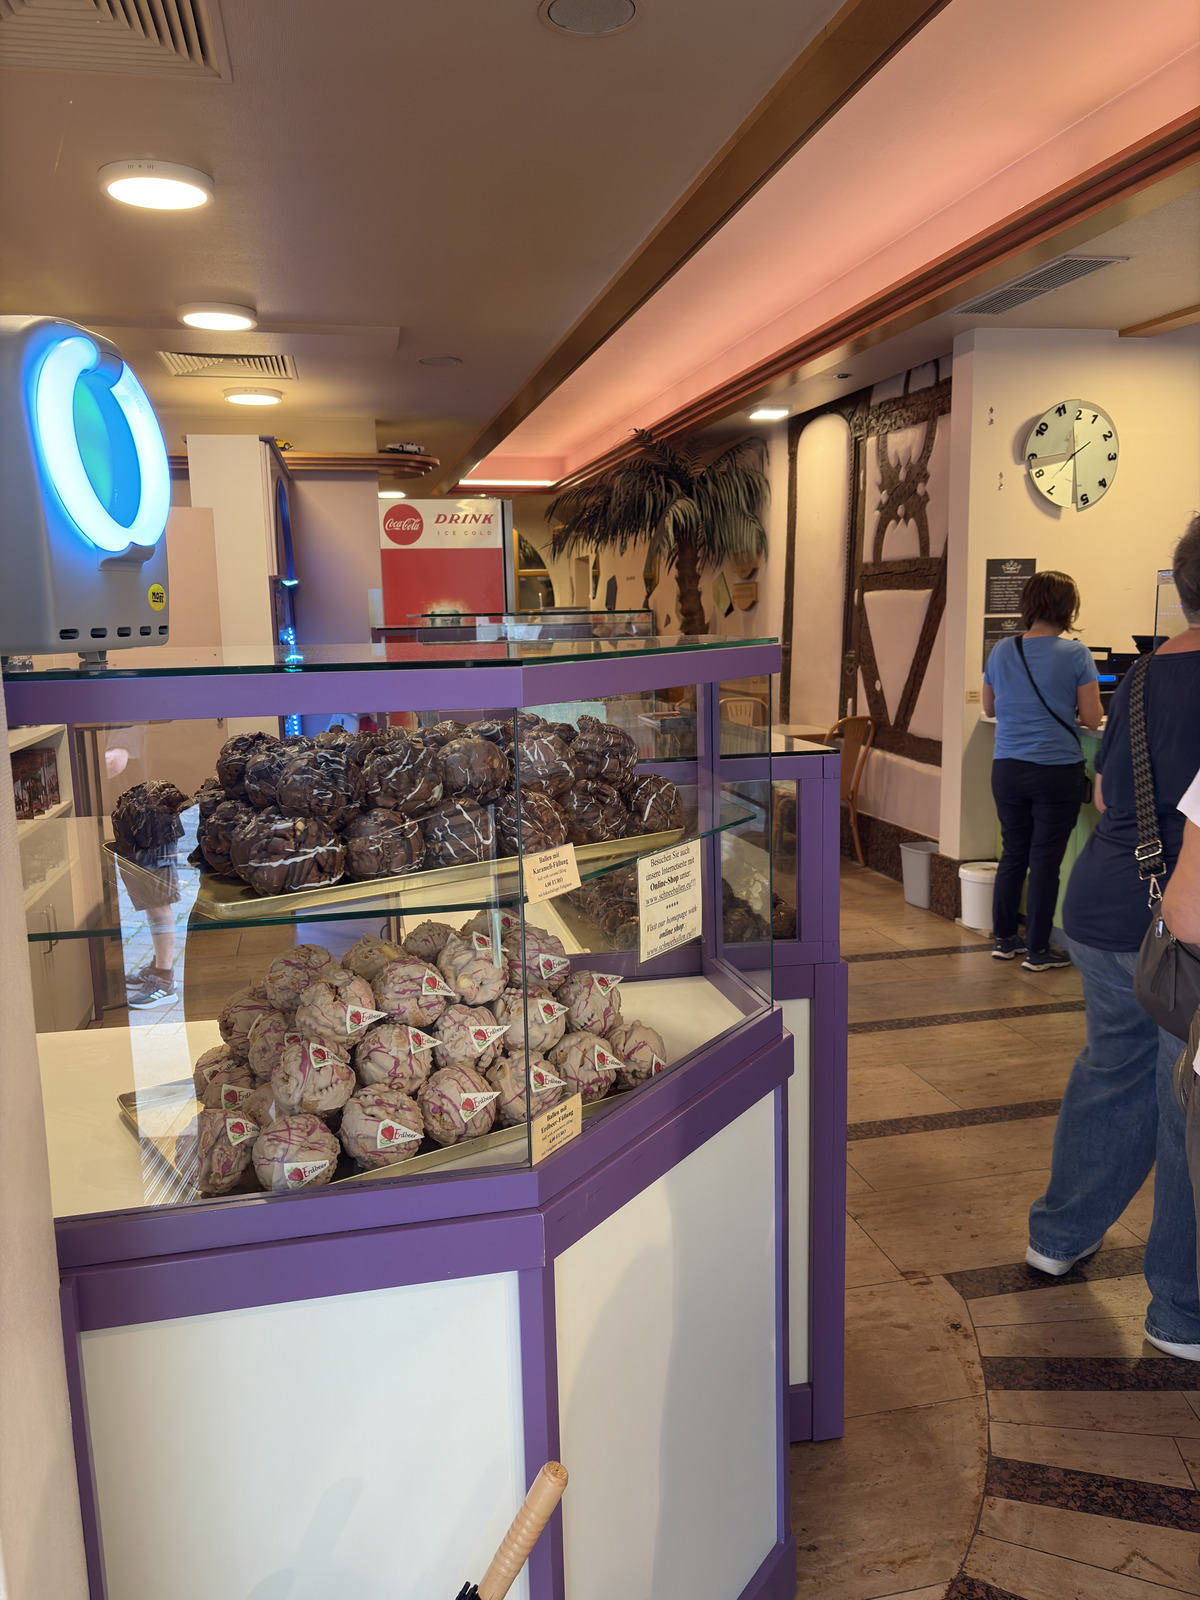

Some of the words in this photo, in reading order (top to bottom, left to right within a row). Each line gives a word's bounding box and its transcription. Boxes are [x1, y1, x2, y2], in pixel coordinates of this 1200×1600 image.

[1035, 422, 1049, 437] 10
[1102, 430, 1113, 442] 2
[1107, 452, 1117, 461] 3
[1034, 468, 1045, 479] 8
[1098, 478, 1108, 489] 4
[1046, 485, 1056, 496] 7
[1080, 493, 1090, 505] 5
[434, 513, 495, 524] DRINK
[539, 854, 552, 863] Ballen
[552, 851, 560, 859] mit
[650, 854, 672, 868] Besuchen
[672, 851, 680, 859] Sie
[680, 846, 690, 857] auch
[645, 870, 661, 881] unsere
[661, 859, 687, 875] Internetseite
[687, 856, 695, 865] mit
[650, 875, 680, 891] Online-Shop
[646, 923, 658, 933] Visit
[657, 920, 666, 929] our
[666, 910, 688, 924] homepage
[687, 904, 697, 914] with
[659, 928, 673, 939] online
[361, 1012, 383, 1023] Erdbeer
[484, 1026, 505, 1038] Erdbeer
[473, 1093, 495, 1108] Erdbeer
[547, 1110, 560, 1121] Ballen
[393, 1128, 418, 1140] Erdbeer
[302, 1162, 328, 1178] Erdbeer
